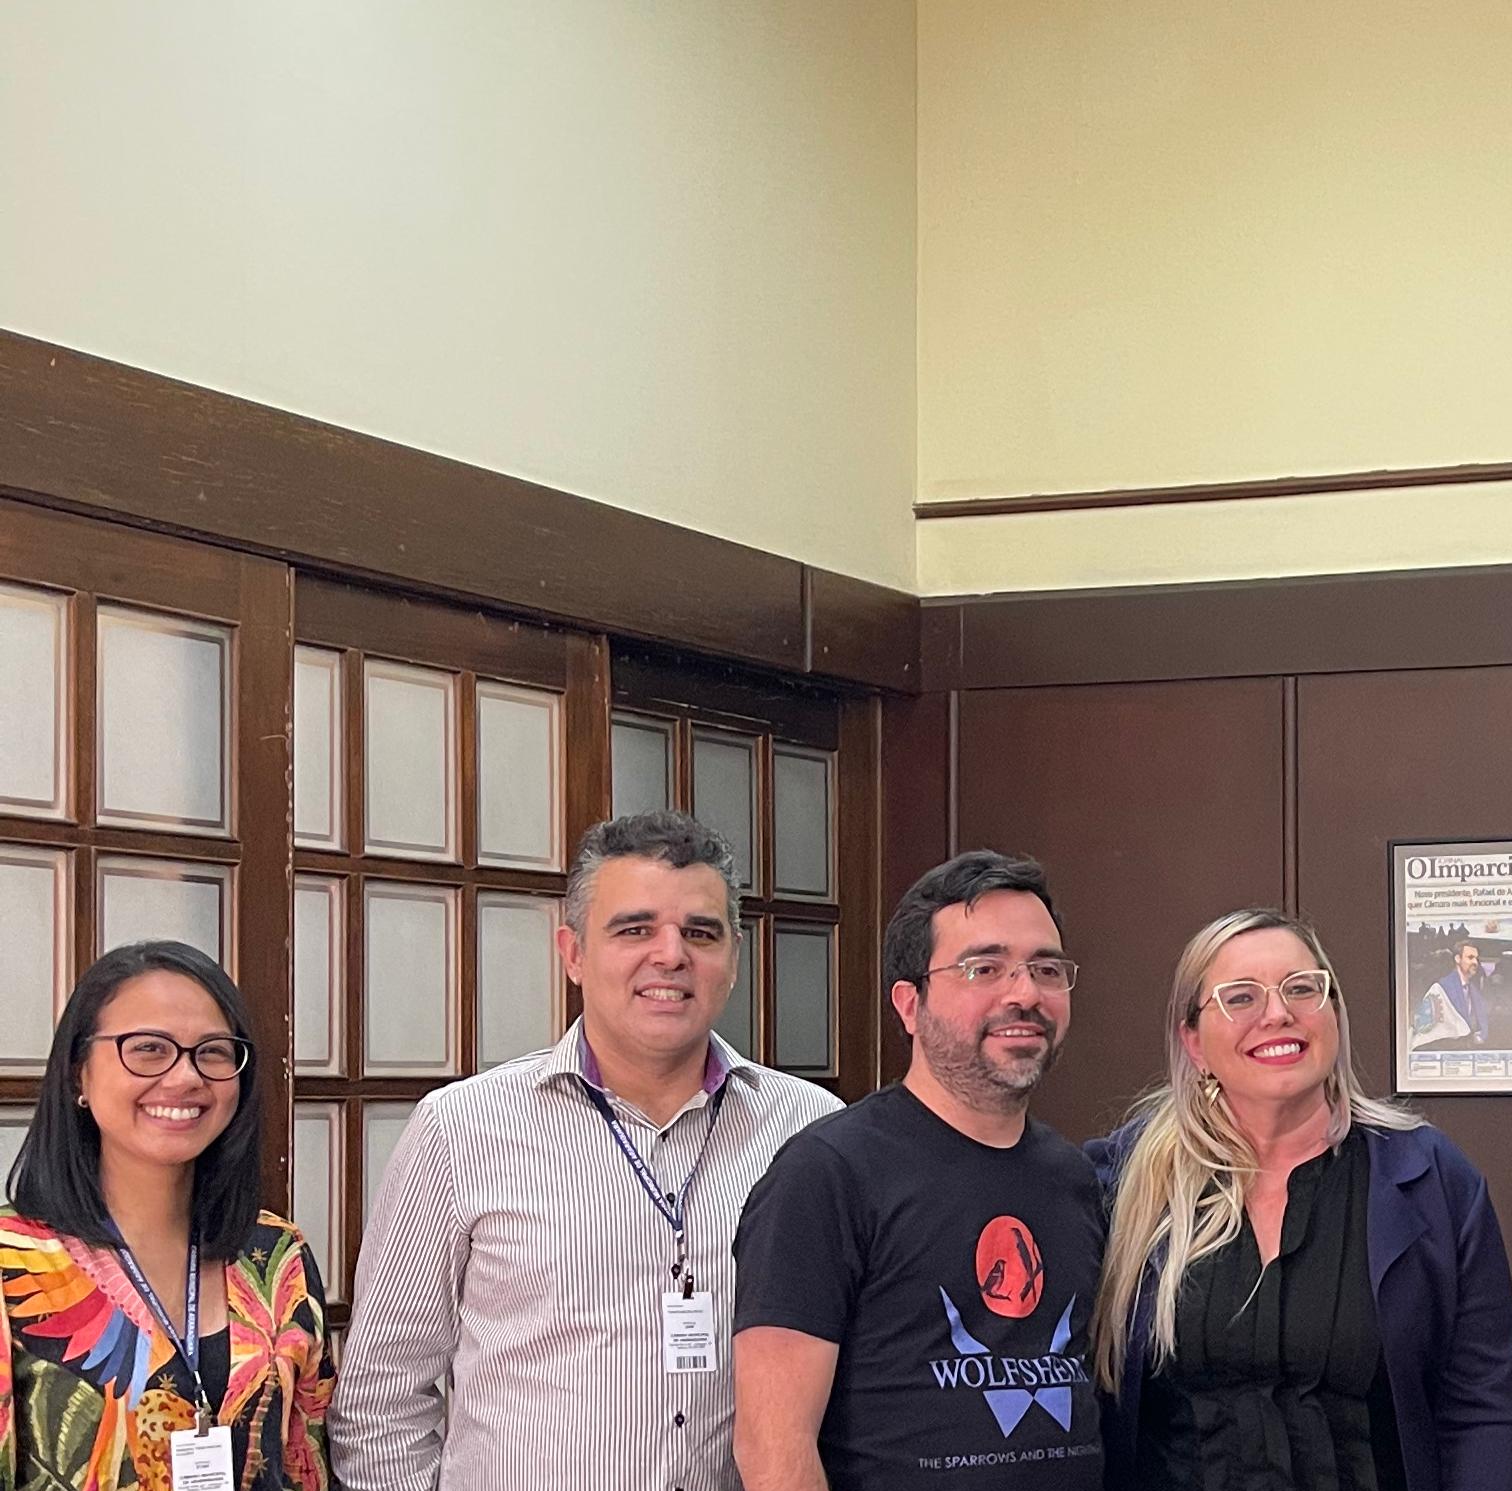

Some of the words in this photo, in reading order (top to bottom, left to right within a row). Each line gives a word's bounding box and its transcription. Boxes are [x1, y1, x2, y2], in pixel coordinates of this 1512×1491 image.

[1407, 902, 1422, 910] quer
[919, 1457, 941, 1469] THE
[944, 1451, 1017, 1469] SPARROWS
[1020, 1449, 1045, 1462] AND
[1047, 1447, 1064, 1459] THE
